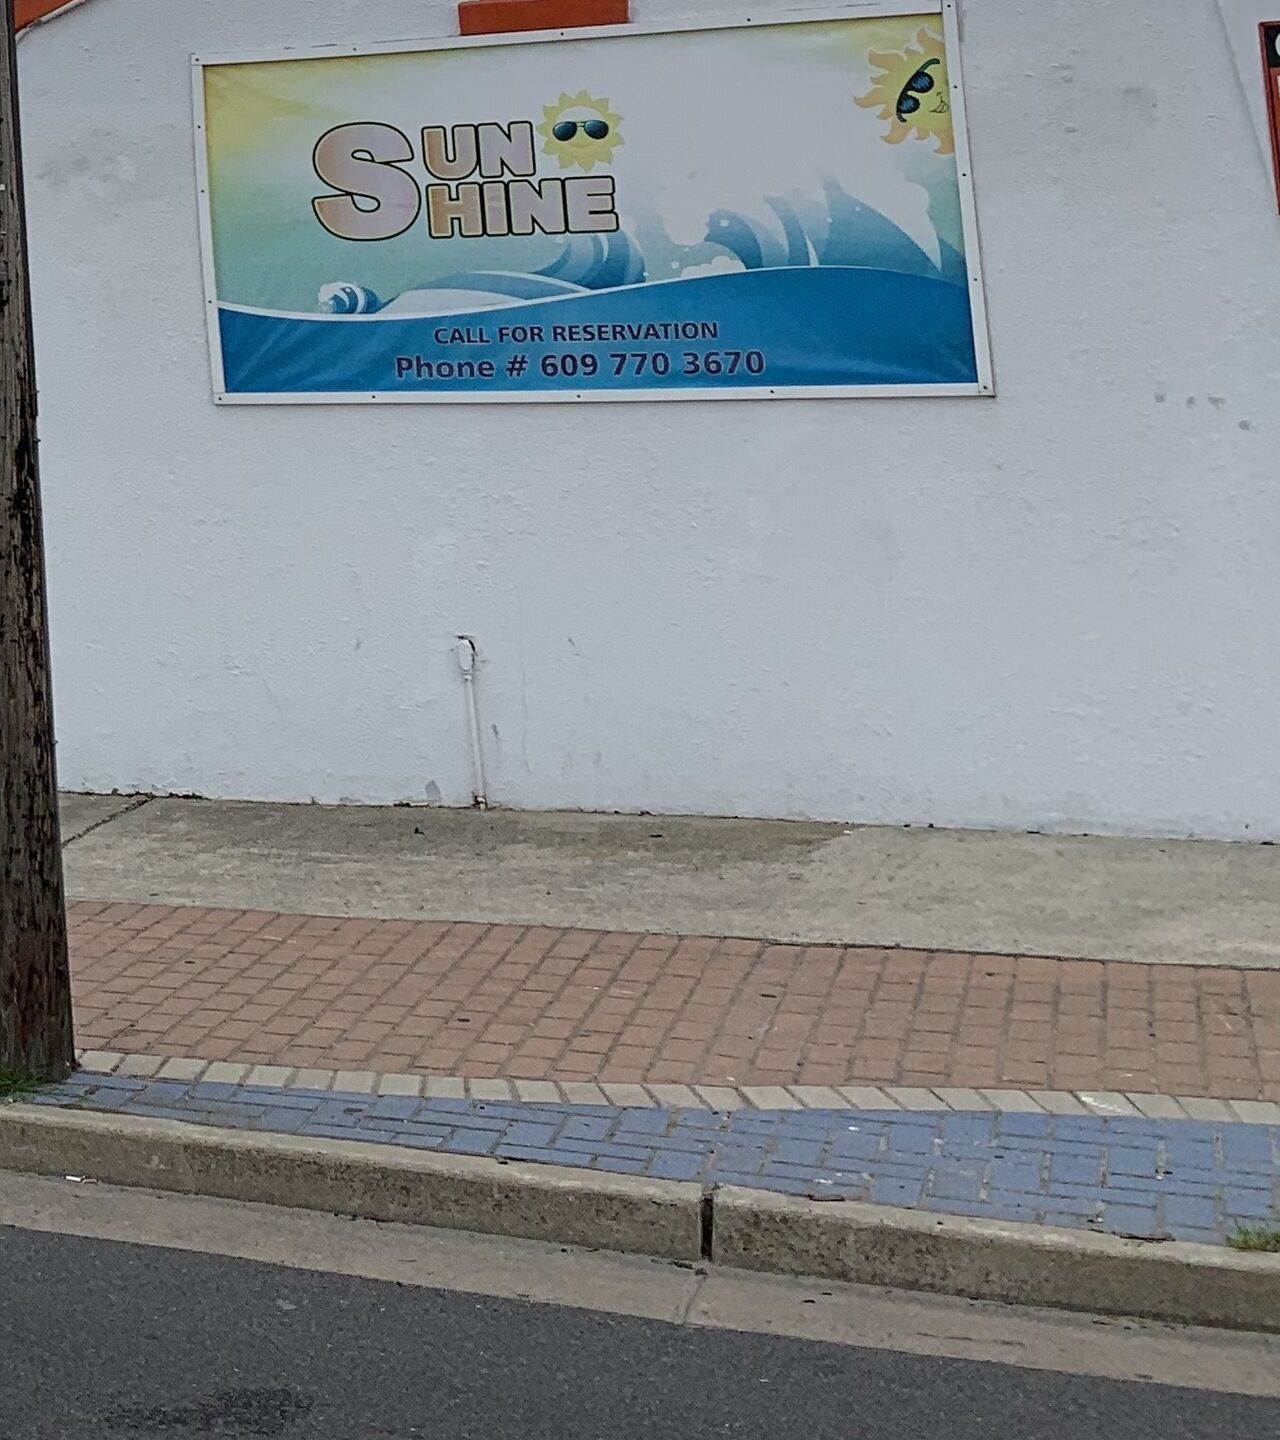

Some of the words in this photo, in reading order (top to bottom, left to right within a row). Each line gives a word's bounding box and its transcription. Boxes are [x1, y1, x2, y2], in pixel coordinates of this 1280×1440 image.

[433, 326, 490, 344] CALL
[498, 325, 545, 343] FOR
[552, 321, 719, 342] RESERVATION
[395, 355, 495, 379] Phone
[506, 355, 528, 377] #
[540, 353, 598, 377] 609
[610, 351, 669, 376] 770
[683, 350, 765, 375] 3670
